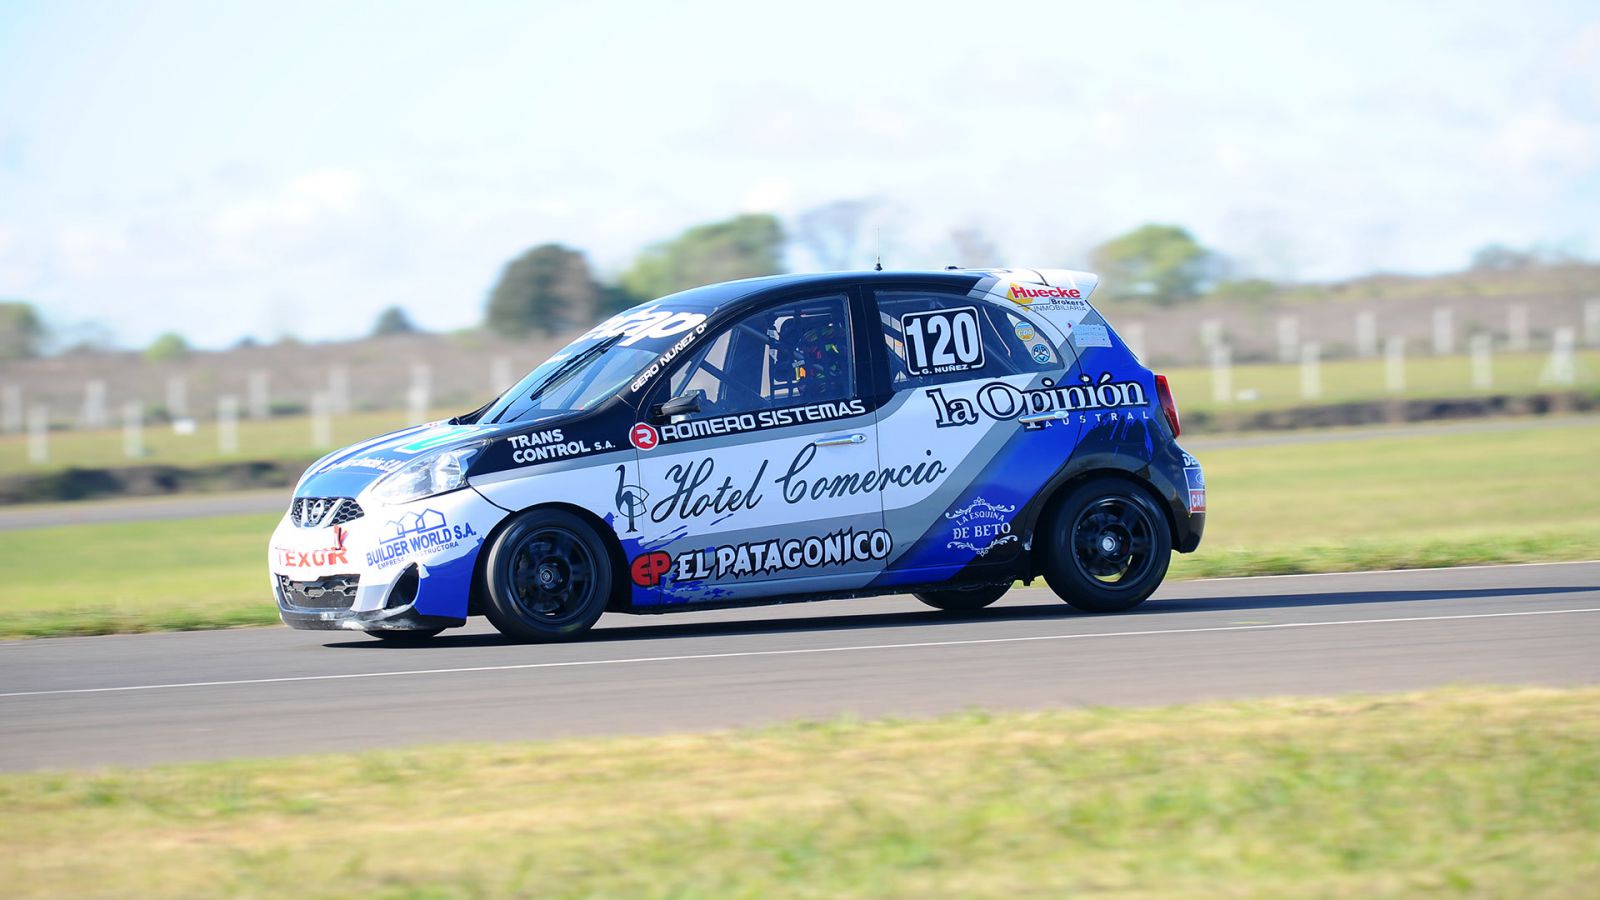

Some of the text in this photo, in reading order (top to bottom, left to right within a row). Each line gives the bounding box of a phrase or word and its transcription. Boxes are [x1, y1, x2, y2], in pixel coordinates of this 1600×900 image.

[1011, 287, 1080, 298] Huecke
[906, 312, 979, 367] 120
[630, 364, 660, 392] GERO
[934, 364, 969, 373] NUÑEZ
[928, 374, 1149, 430] la Opinión
[661, 413, 755, 441] ROMERO
[758, 399, 866, 427] SISTEMAS
[1045, 411, 1149, 427] AUSTRAL
[507, 429, 564, 449] TRANS
[513, 440, 616, 464] CONTROL S.A.
[650, 442, 947, 523] Hotel Comercio
[952, 522, 1011, 540] DE BETO
[956, 511, 1005, 526] LA ESQUINA
[366, 522, 477, 567] BUILDER WORLD S.A.
[631, 528, 892, 587] EP EL PATAGONICO
